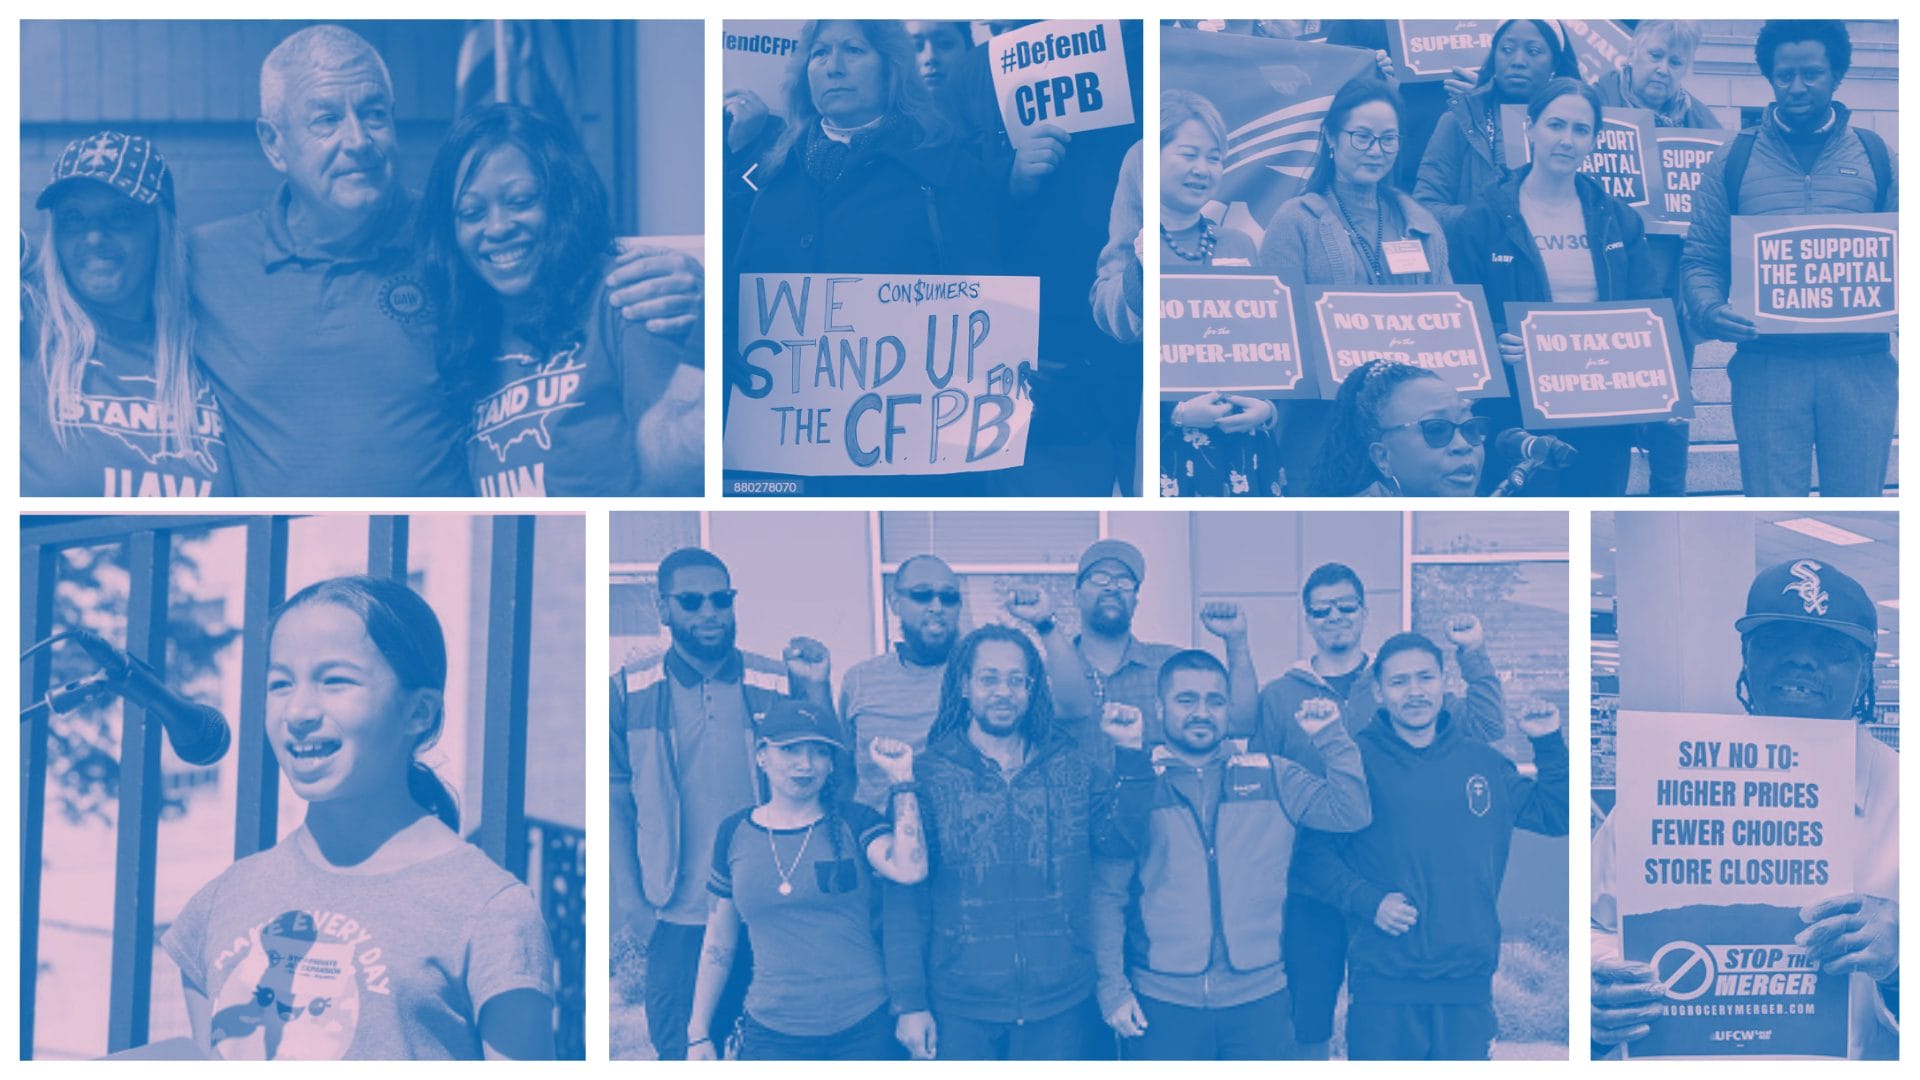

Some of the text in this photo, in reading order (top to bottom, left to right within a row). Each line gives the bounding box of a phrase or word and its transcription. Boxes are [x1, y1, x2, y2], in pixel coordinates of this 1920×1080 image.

[1000, 24, 1106, 74] #Defend
[1015, 72, 1103, 126] CFPB
[1576, 153, 1641, 175] APITAL
[1601, 176, 1636, 198] TAX
[1761, 237, 1891, 261] WE SUPPORT
[1760, 261, 1892, 285] THE CAPITAL
[755, 276, 864, 337] WE
[1187, 299, 1233, 319] TAX
[1234, 299, 1278, 319] CUT
[1772, 285, 1881, 309] GAINS TAX
[1333, 312, 1462, 331] NO TAX CUT
[1160, 342, 1291, 363] UPER-RICH
[1535, 330, 1653, 352] NO TAX CUT
[731, 309, 1033, 401] STAND UP FOR
[536, 373, 580, 407] UP
[1537, 368, 1668, 393] SUPER-RICH
[769, 406, 832, 446] THE
[1679, 740, 1799, 770] SAY NO TO:
[1657, 779, 1819, 808] HIGHER PRICES
[1651, 818, 1824, 847] FEWER CHOICES
[1644, 858, 1829, 886] STORE CLOSURES
[291, 910, 372, 946] EVERY
[357, 947, 391, 995] DAY
[1724, 948, 1784, 970] STOP
[1714, 973, 1818, 997] MERGER
